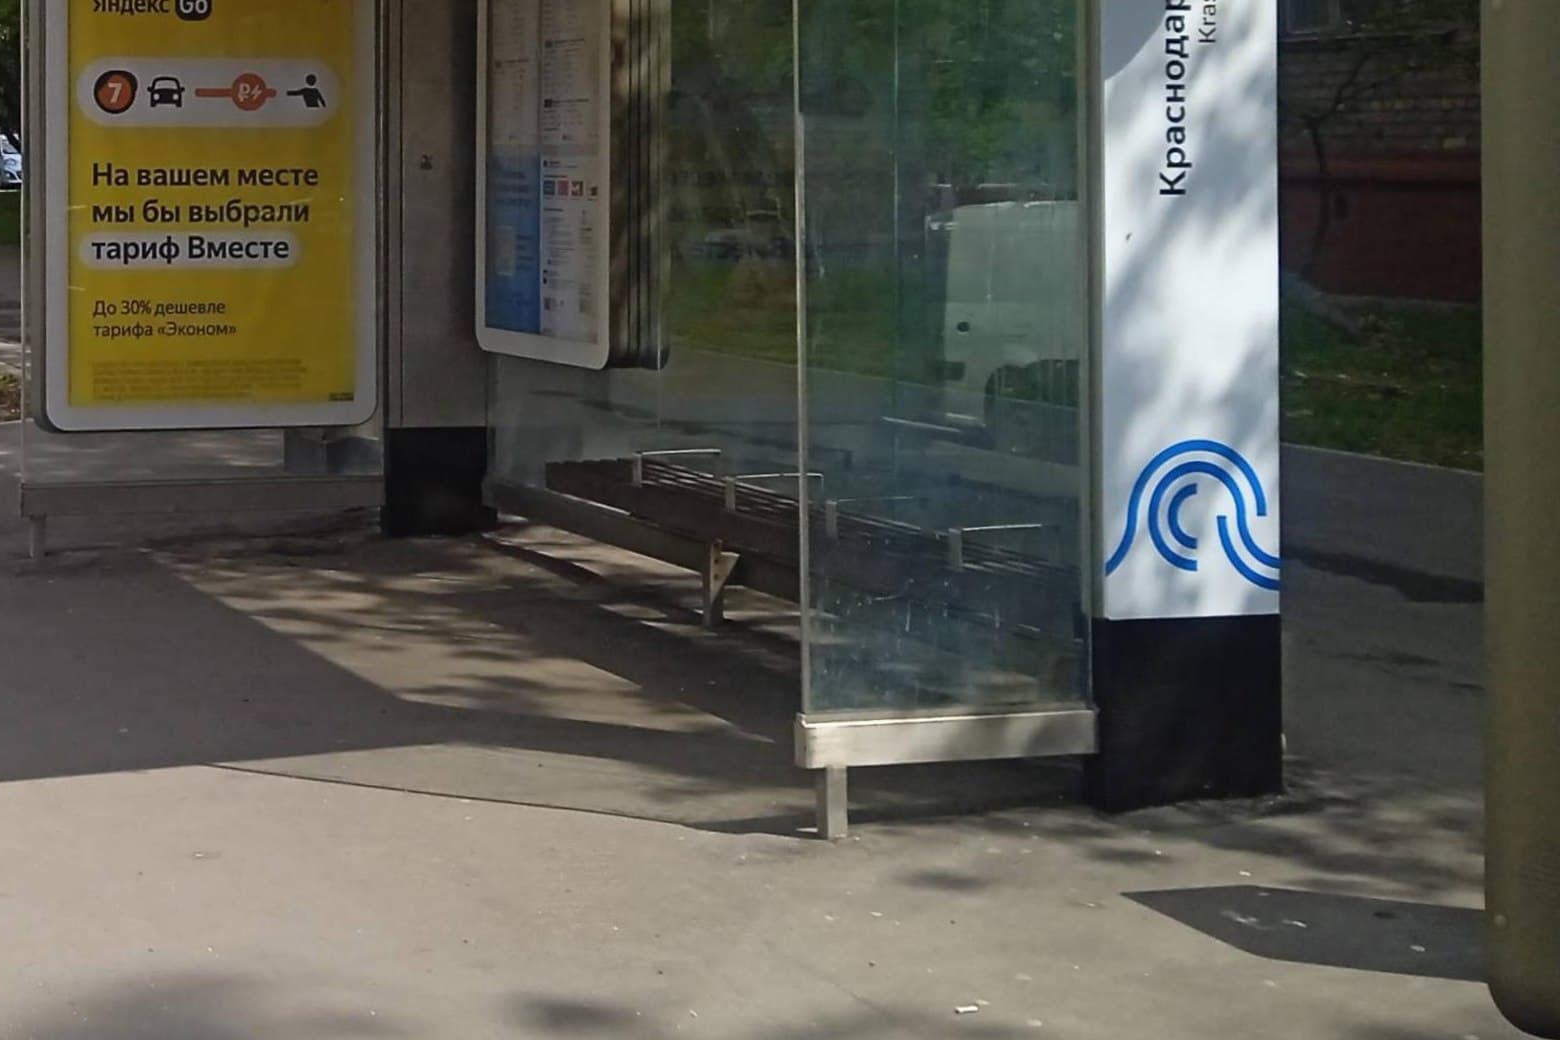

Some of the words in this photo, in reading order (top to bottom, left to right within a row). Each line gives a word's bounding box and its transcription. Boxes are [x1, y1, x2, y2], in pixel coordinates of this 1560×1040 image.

[108, 82, 124, 104] 7
[92, 162, 130, 187] На
[137, 166, 230, 187] вашем
[237, 166, 319, 187] месте
[92, 204, 135, 224] мы
[142, 199, 181, 223] бы
[189, 198, 310, 228] выбрали
[91, 235, 181, 265] тариф
[188, 235, 290, 260] Вместе
[92, 300, 117, 318] До
[121, 299, 152, 315] 30%
[154, 301, 226, 318] дешевле
[93, 320, 153, 339] тарифа
[157, 320, 237, 337] «Эконом»
